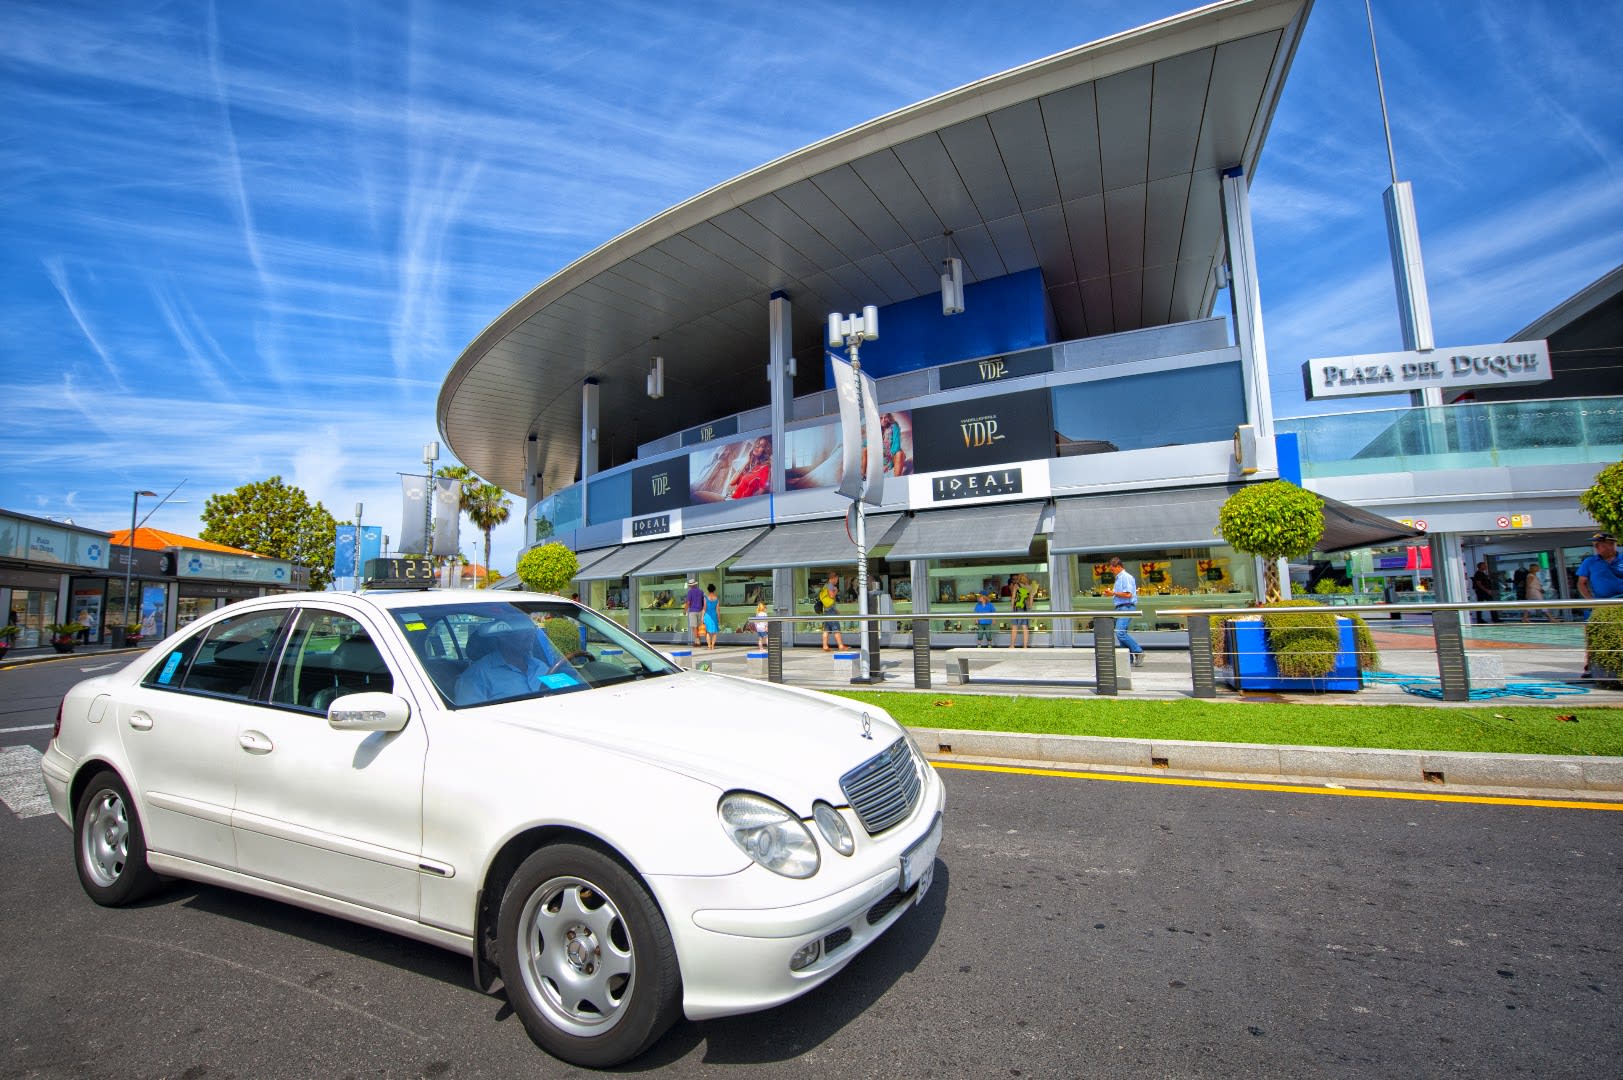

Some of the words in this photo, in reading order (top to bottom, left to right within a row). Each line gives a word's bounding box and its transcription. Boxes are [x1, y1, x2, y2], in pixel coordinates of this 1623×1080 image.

[979, 361, 1004, 381] VDP
[960, 420, 998, 448] VDP
[652, 476, 668, 496] VDP
[939, 472, 1014, 492] IDEAL
[634, 517, 667, 531] IDEAL
[392, 559, 432, 579] 123
